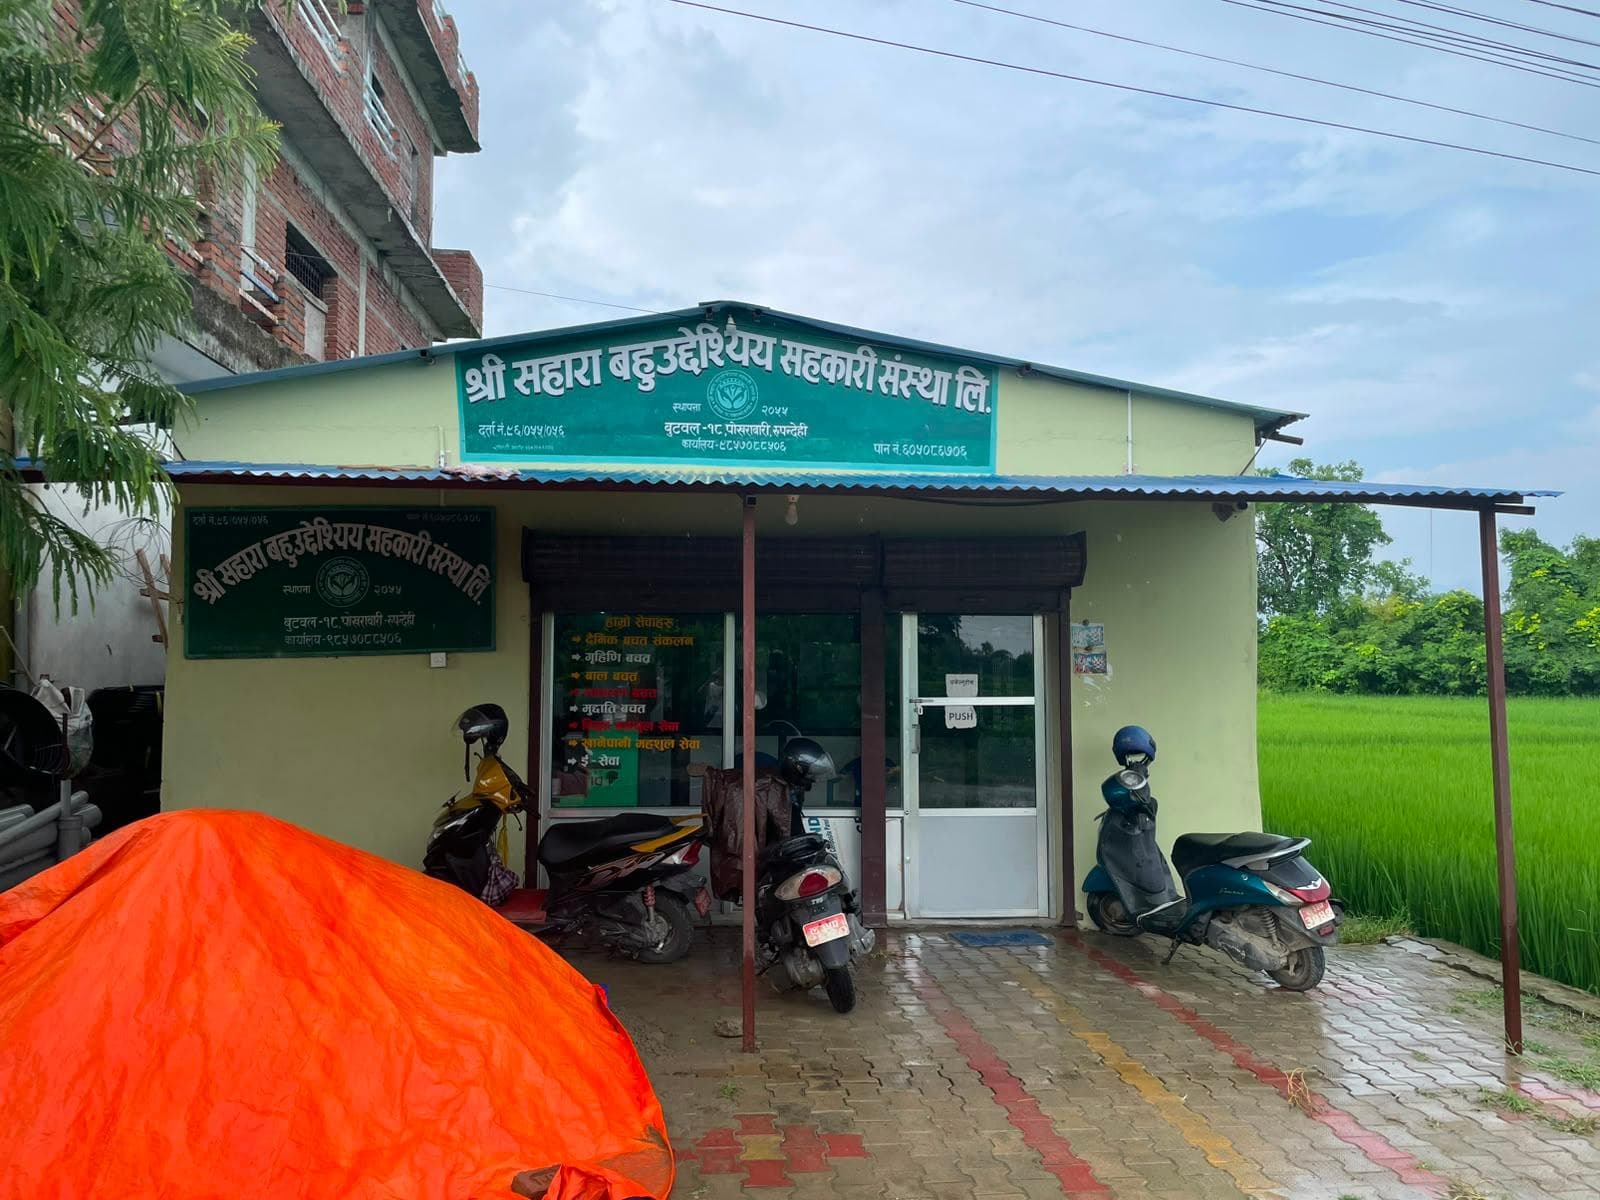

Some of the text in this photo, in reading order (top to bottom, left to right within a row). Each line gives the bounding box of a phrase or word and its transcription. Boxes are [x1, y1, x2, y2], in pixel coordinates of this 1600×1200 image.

[465, 353, 506, 402] श्री
[512, 350, 602, 395] सहारा
[780, 339, 878, 391] सहकारी
[878, 354, 952, 405] संस्था
[955, 366, 991, 413] लि.
[672, 402, 788, 415] स्थापना २०५५
[478, 421, 496, 438] दर्ता
[874, 442, 890, 455] पान
[193, 568, 226, 605] श्री
[215, 542, 268, 586] सहारा
[366, 524, 432, 565] सहकारी
[427, 542, 473, 588] संस्था
[283, 585, 311, 595] स्थापना
[283, 616, 317, 632] बुटवल
[624, 636, 648, 647] बचत
[625, 653, 651, 664] बचत
[585, 671, 639, 682] बाल बचत
[620, 703, 646, 713] बचत
[949, 712, 974, 721] PUSH
[680, 737, 700, 750] सेवा
